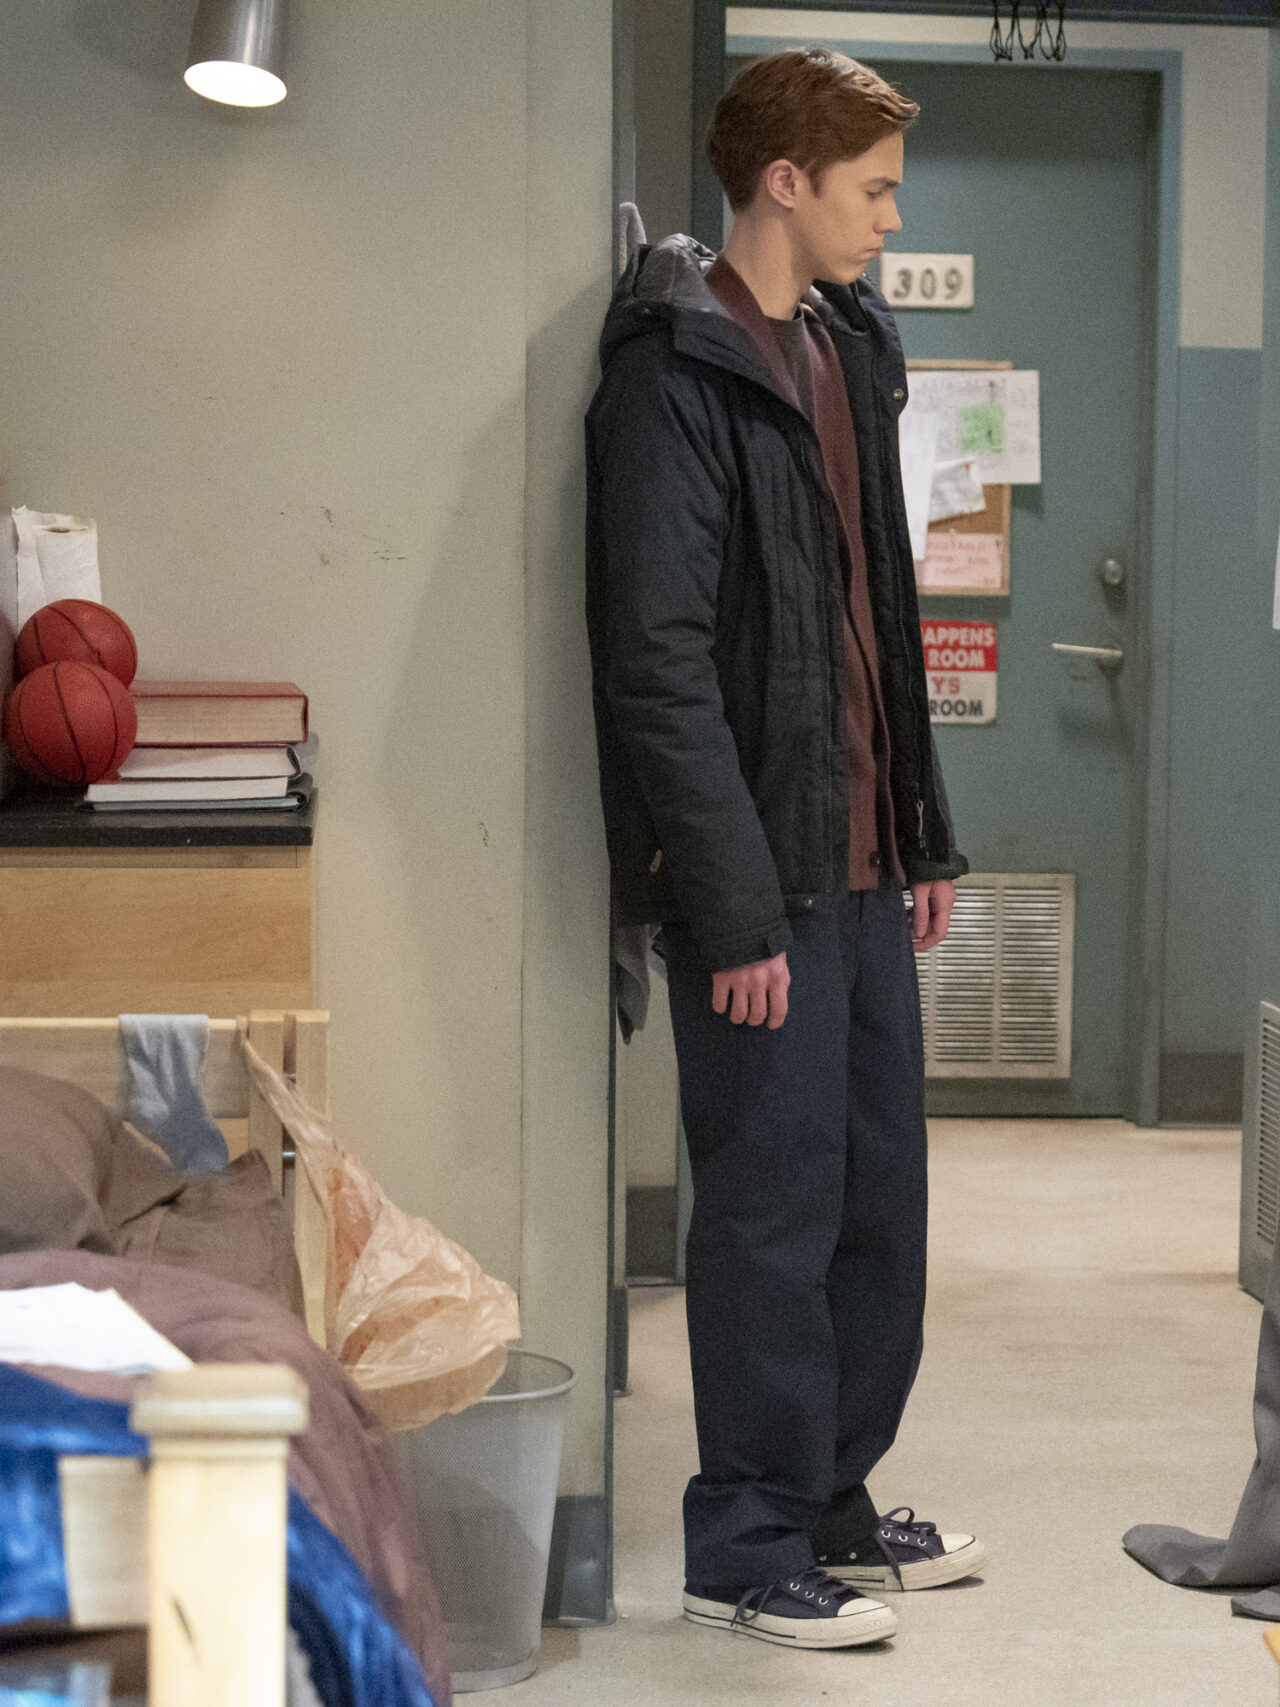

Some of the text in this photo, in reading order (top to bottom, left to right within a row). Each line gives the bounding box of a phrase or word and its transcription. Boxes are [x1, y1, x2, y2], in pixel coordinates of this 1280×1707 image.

[893, 267, 963, 300] 309
[921, 626, 995, 647] APPENS
[928, 648, 985, 668] ROOM
[930, 676, 961, 695] YS
[929, 699, 983, 717] ROOM
